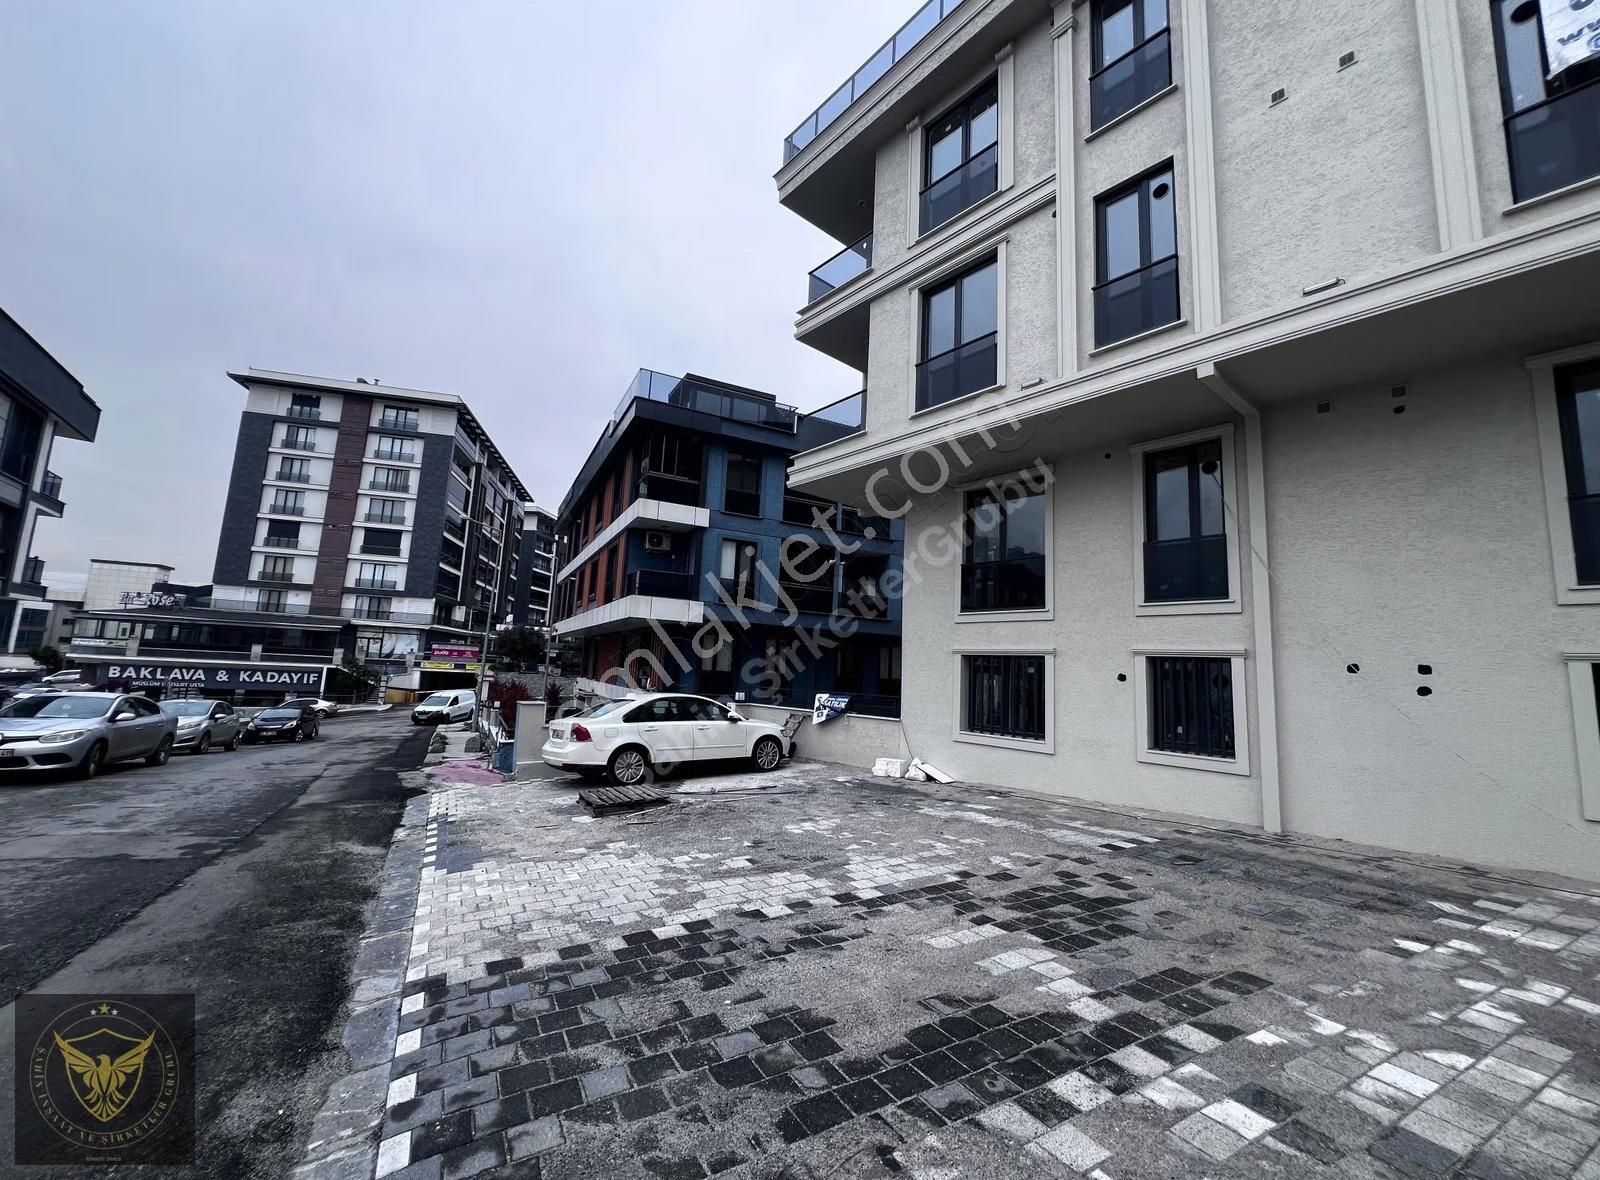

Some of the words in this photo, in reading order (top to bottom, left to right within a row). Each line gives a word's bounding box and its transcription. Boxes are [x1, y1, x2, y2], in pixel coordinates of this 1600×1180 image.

[108, 666, 206, 681] BAKLAVA
[216, 670, 229, 682] &
[239, 670, 319, 684] KADAYIF
